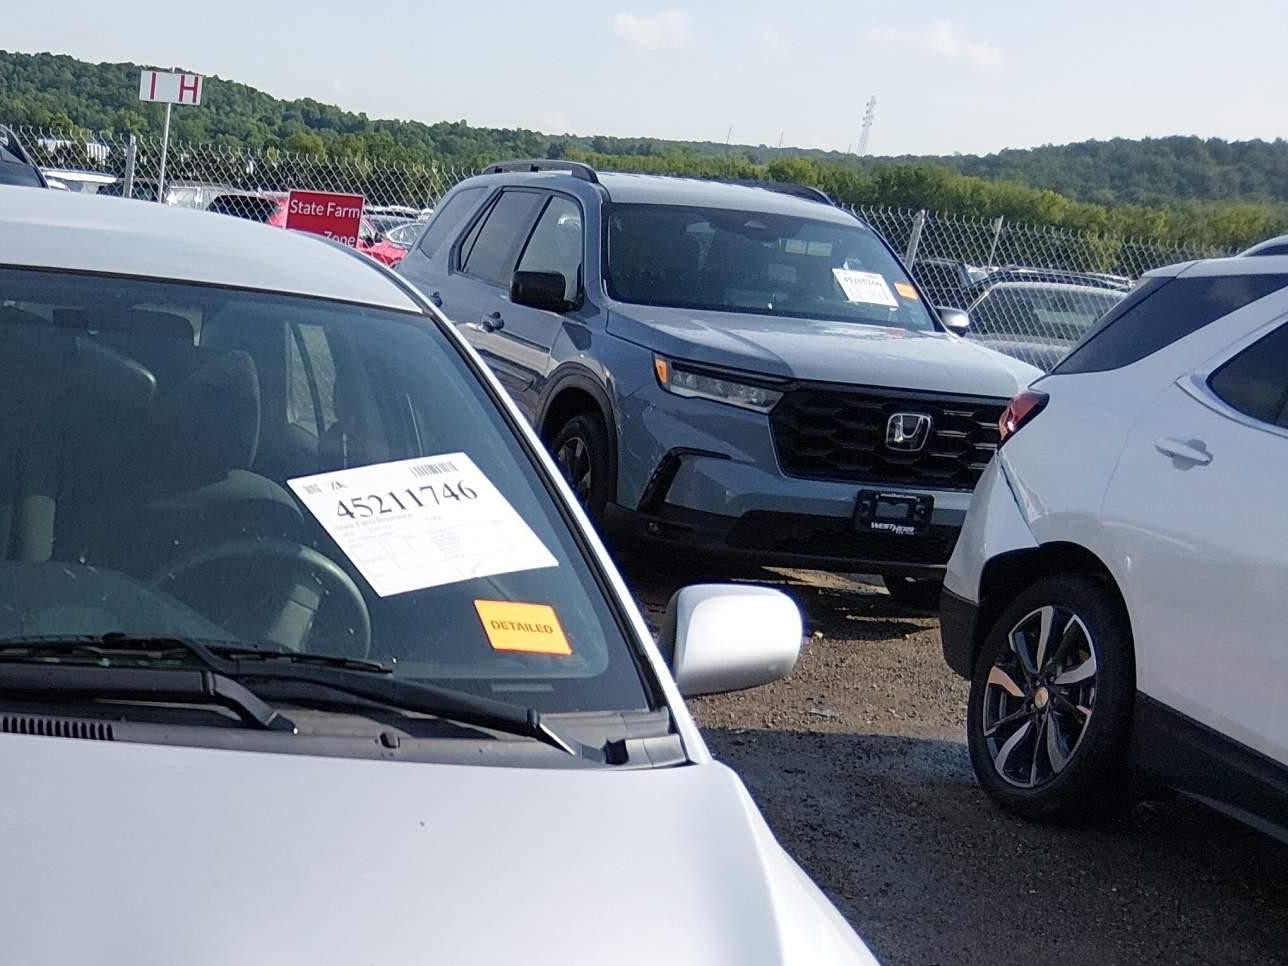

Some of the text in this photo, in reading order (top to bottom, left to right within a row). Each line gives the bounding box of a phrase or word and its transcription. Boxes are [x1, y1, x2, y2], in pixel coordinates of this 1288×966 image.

[179, 74, 199, 103] H
[290, 200, 361, 218] State Farm
[336, 479, 479, 520] 45211746
[490, 620, 554, 635] DETAILED
